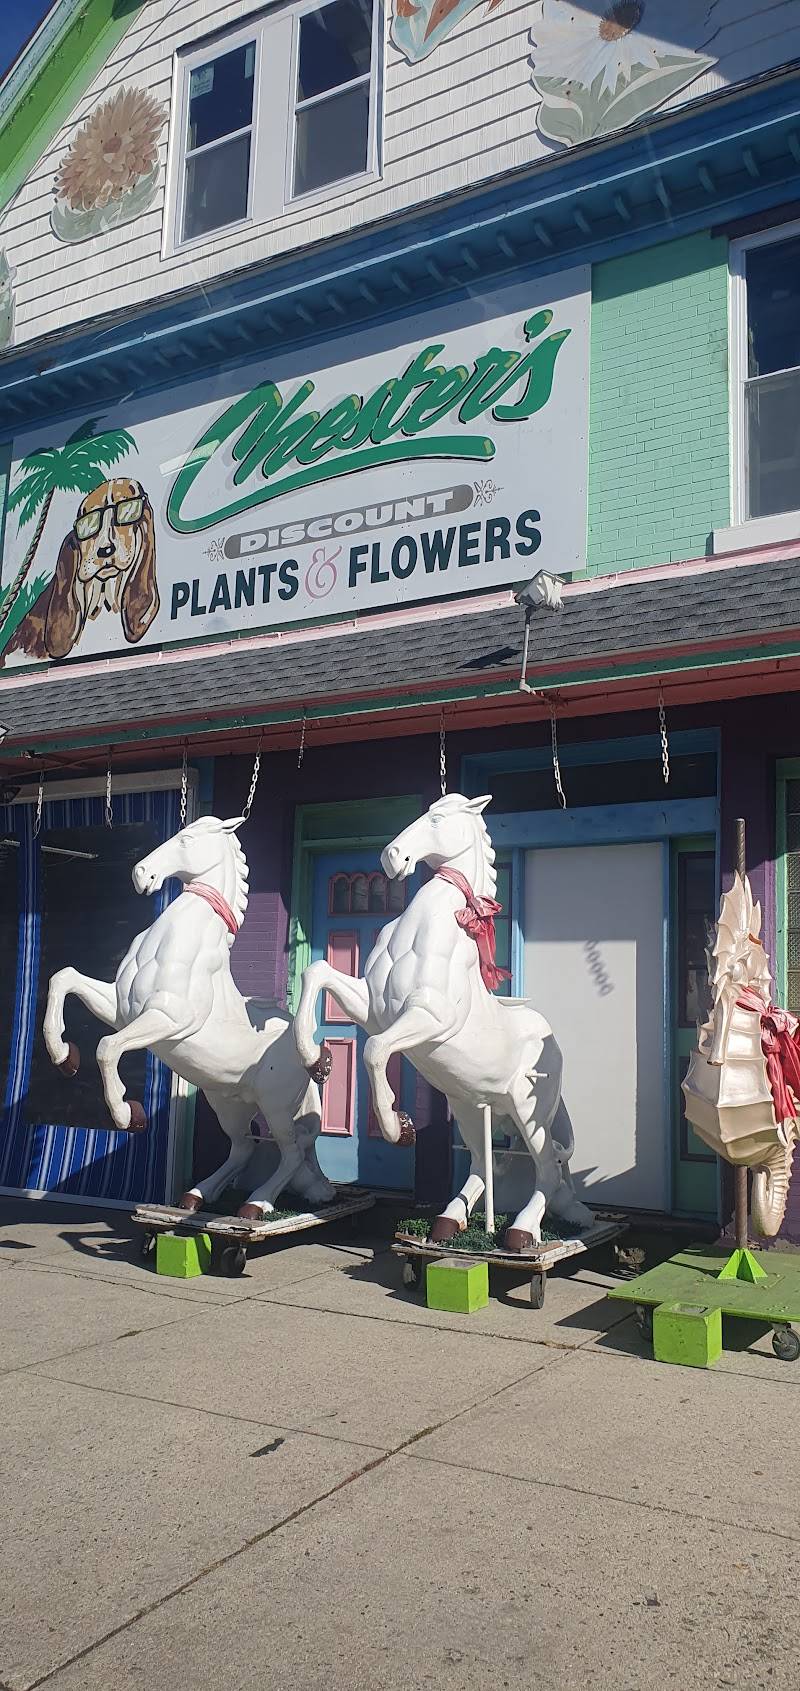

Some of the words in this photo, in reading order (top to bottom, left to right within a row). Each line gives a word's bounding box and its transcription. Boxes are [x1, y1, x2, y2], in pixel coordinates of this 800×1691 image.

[167, 309, 570, 534] Chester's
[170, 559, 299, 620] PLANTS
[304, 545, 343, 599] &
[348, 509, 541, 588] FLOWERS
[240, 490, 455, 551] DISCOUNT
